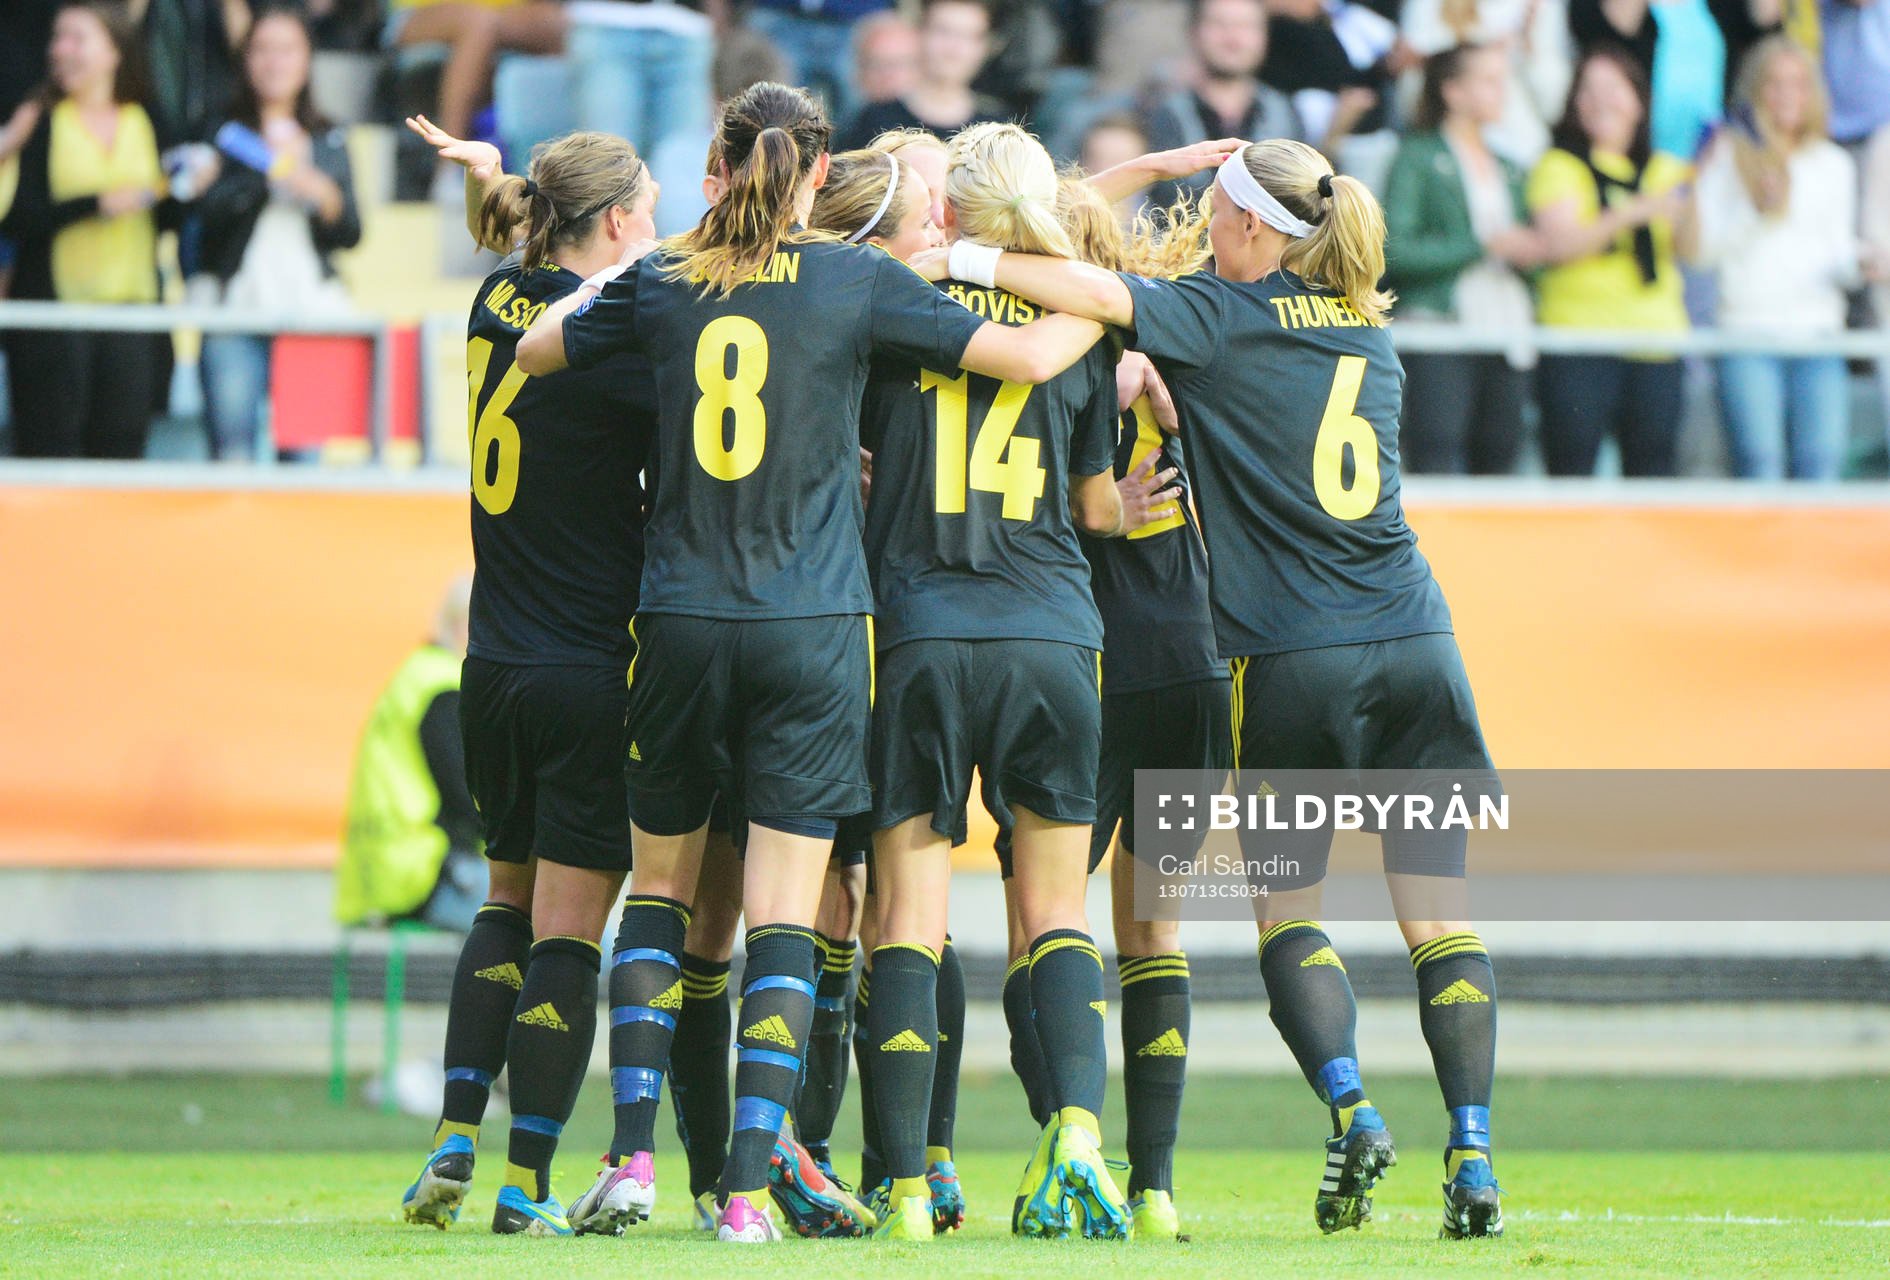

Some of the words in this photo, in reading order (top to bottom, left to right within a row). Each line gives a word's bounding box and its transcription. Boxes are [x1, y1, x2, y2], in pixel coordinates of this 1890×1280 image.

[693, 315, 769, 481] 8
[920, 369, 1046, 522] 14
[1312, 355, 1381, 521] 6
[743, 1025, 796, 1048] adidas
[880, 1042, 931, 1052] adidas
